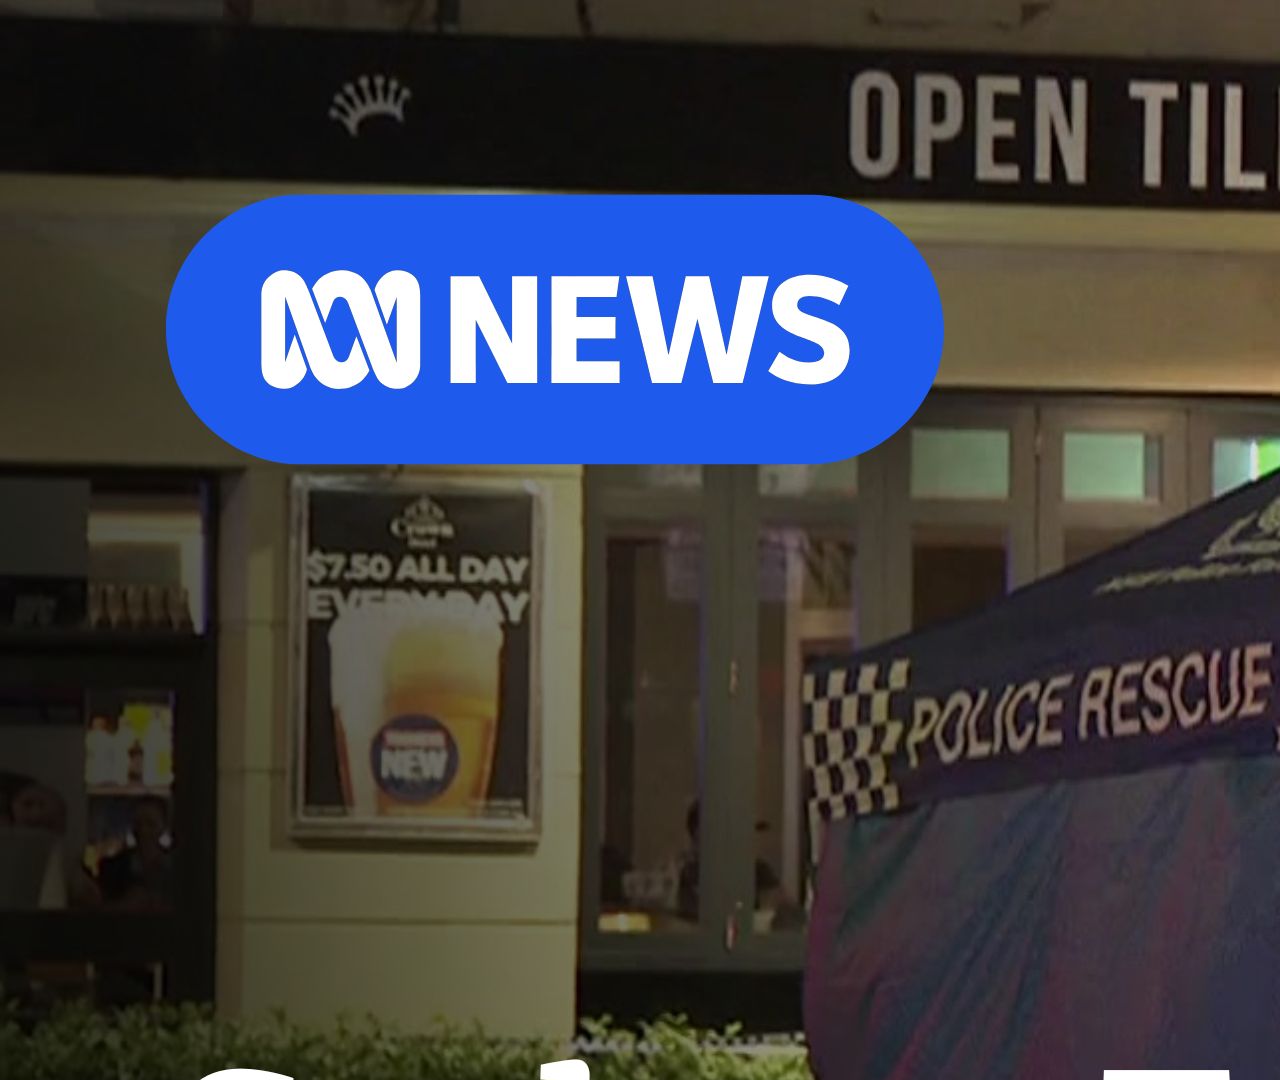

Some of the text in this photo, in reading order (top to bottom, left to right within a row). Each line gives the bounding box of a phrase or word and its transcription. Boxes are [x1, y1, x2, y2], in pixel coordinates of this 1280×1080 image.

[849, 68, 1090, 185] OPEN
[306, 551, 529, 584] $7.50 ALL DAY
[905, 642, 1273, 769] POLICE RESCUE
[381, 748, 449, 781] NEW
